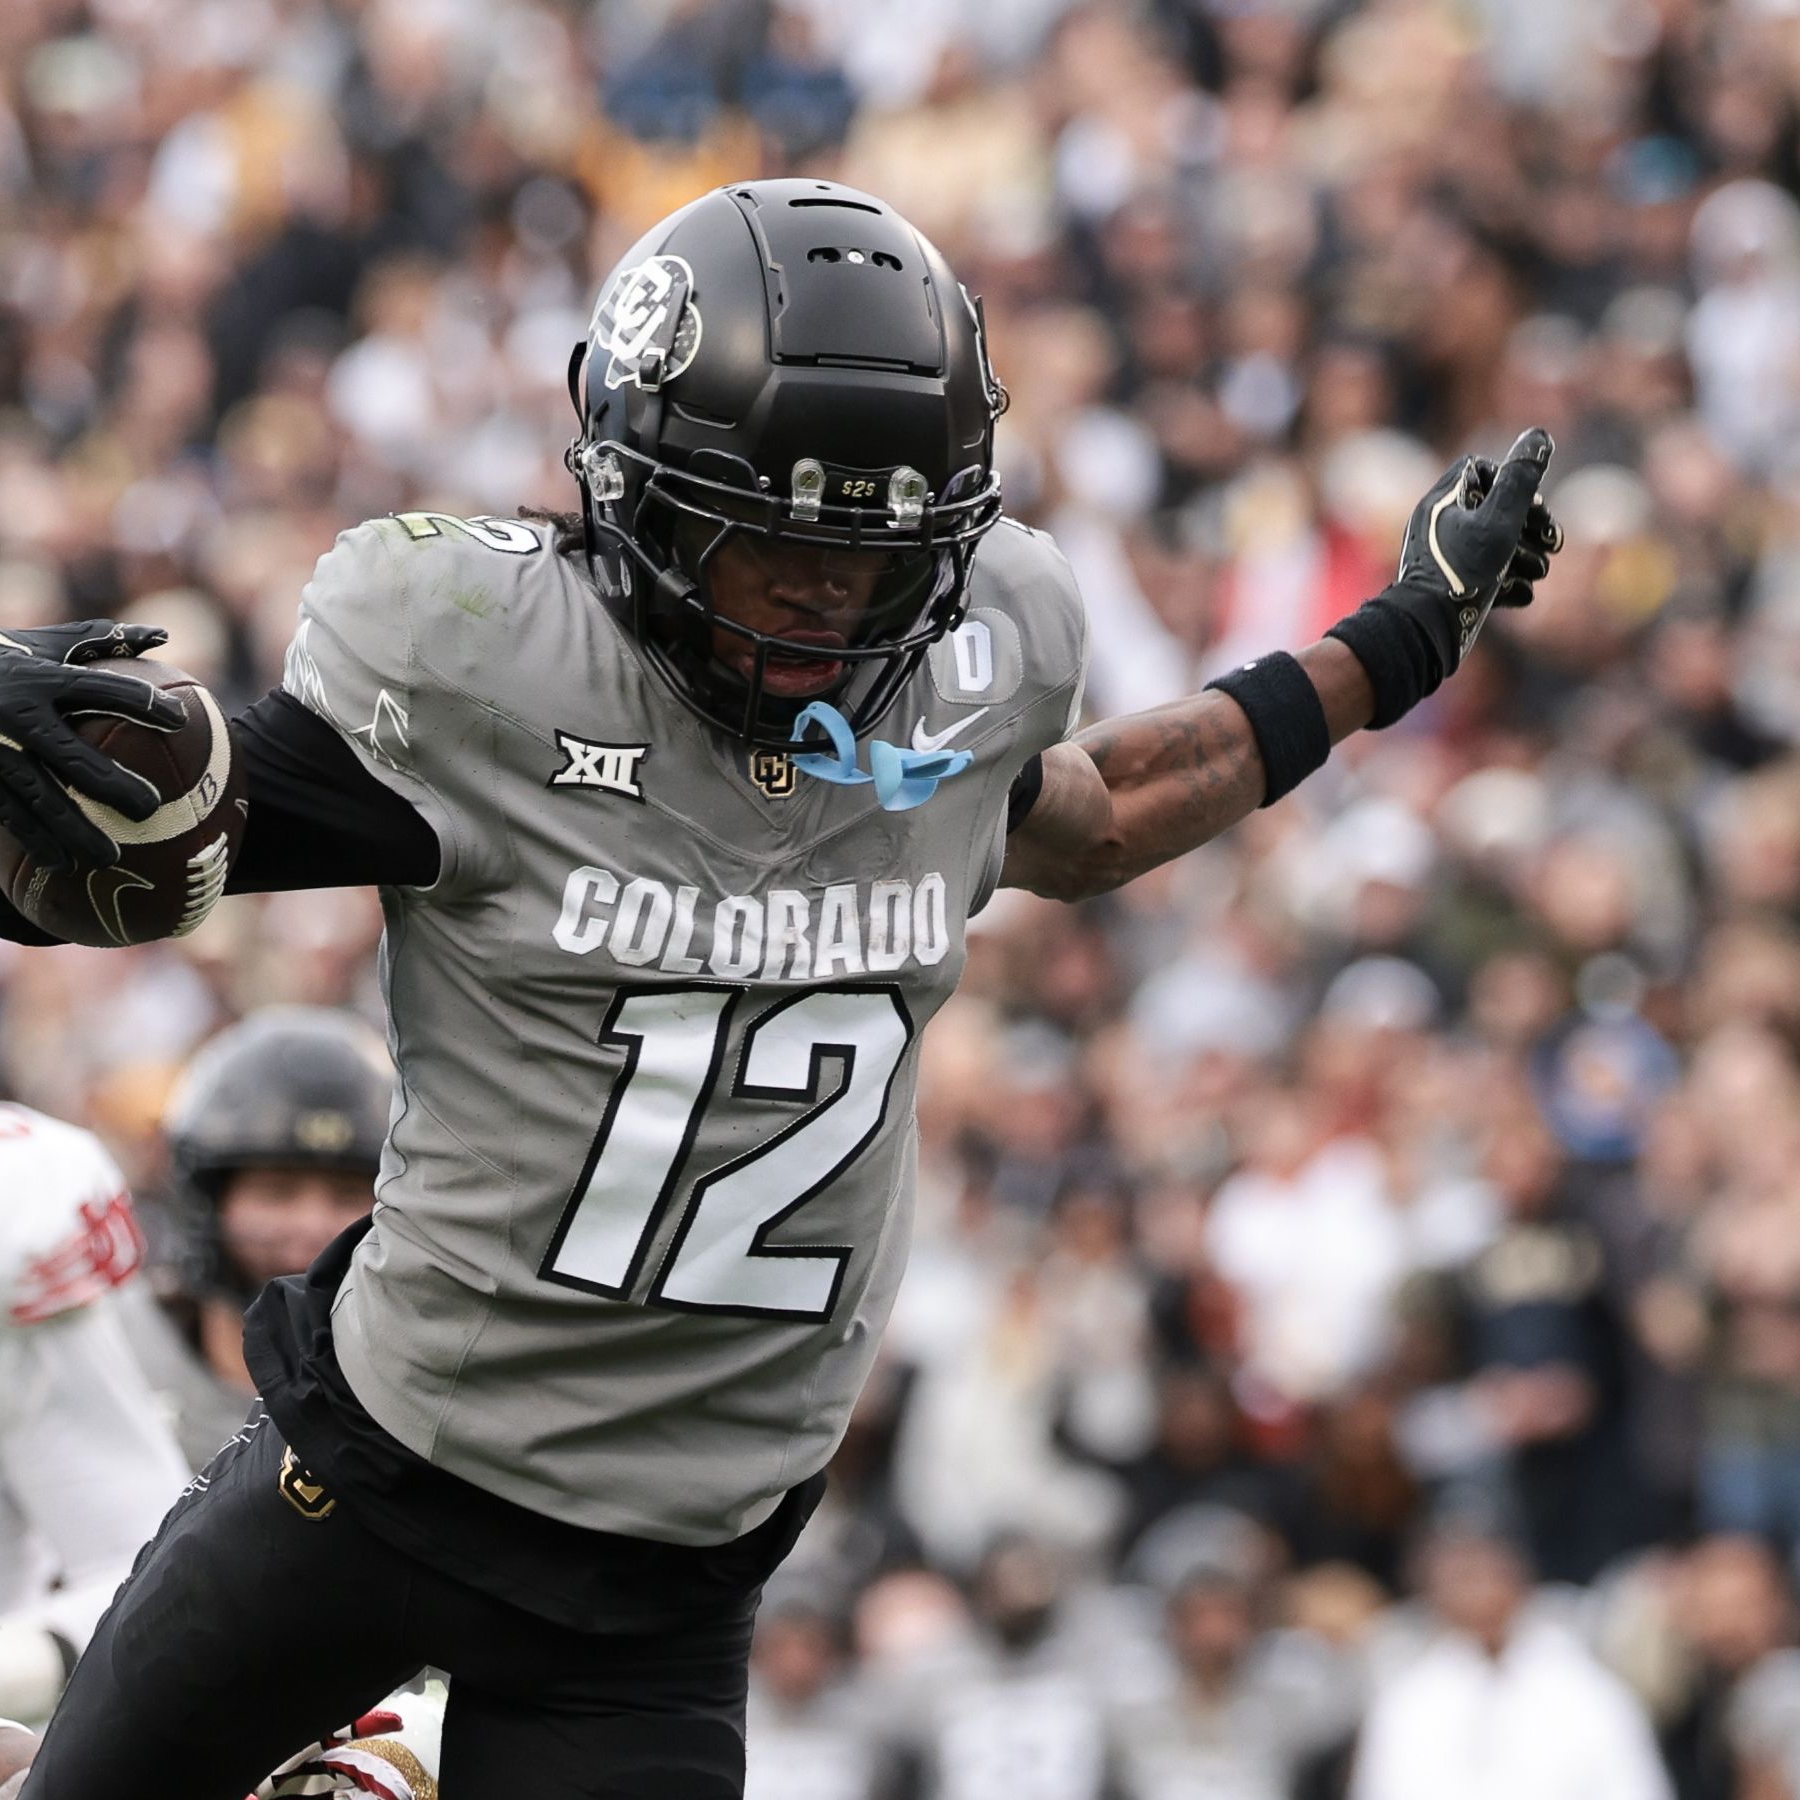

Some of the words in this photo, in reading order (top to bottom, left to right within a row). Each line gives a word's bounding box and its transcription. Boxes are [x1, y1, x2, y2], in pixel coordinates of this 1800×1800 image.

[551, 733, 648, 799] XII
[551, 865, 951, 981] COLORADO
[536, 980, 915, 1325] 12
